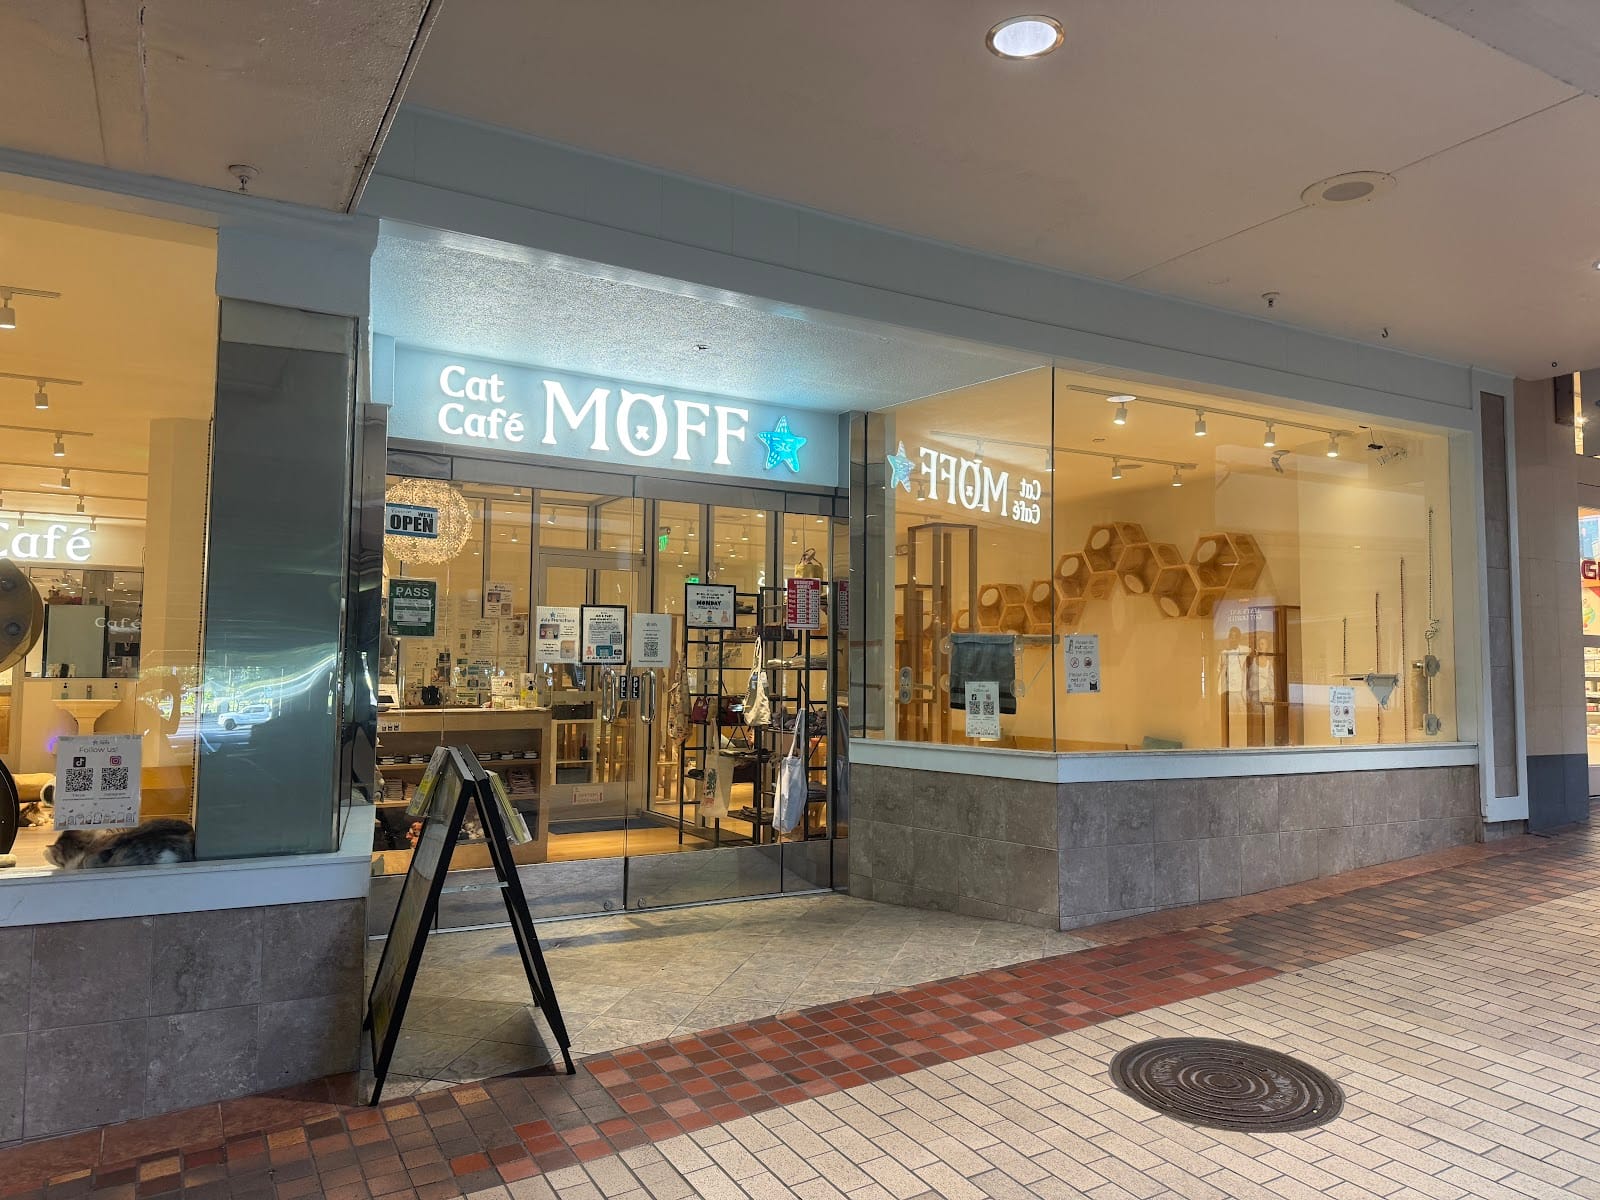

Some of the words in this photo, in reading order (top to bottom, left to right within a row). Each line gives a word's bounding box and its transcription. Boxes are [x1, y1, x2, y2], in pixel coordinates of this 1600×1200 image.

[440, 365, 505, 402] Cat
[438, 402, 525, 442] Café
[542, 379, 749, 465] MOFF
[390, 514, 434, 533] OPEN
[1581, 559, 1600, 580] G
[396, 586, 430, 597] PASS
[95, 617, 141, 629] Café
